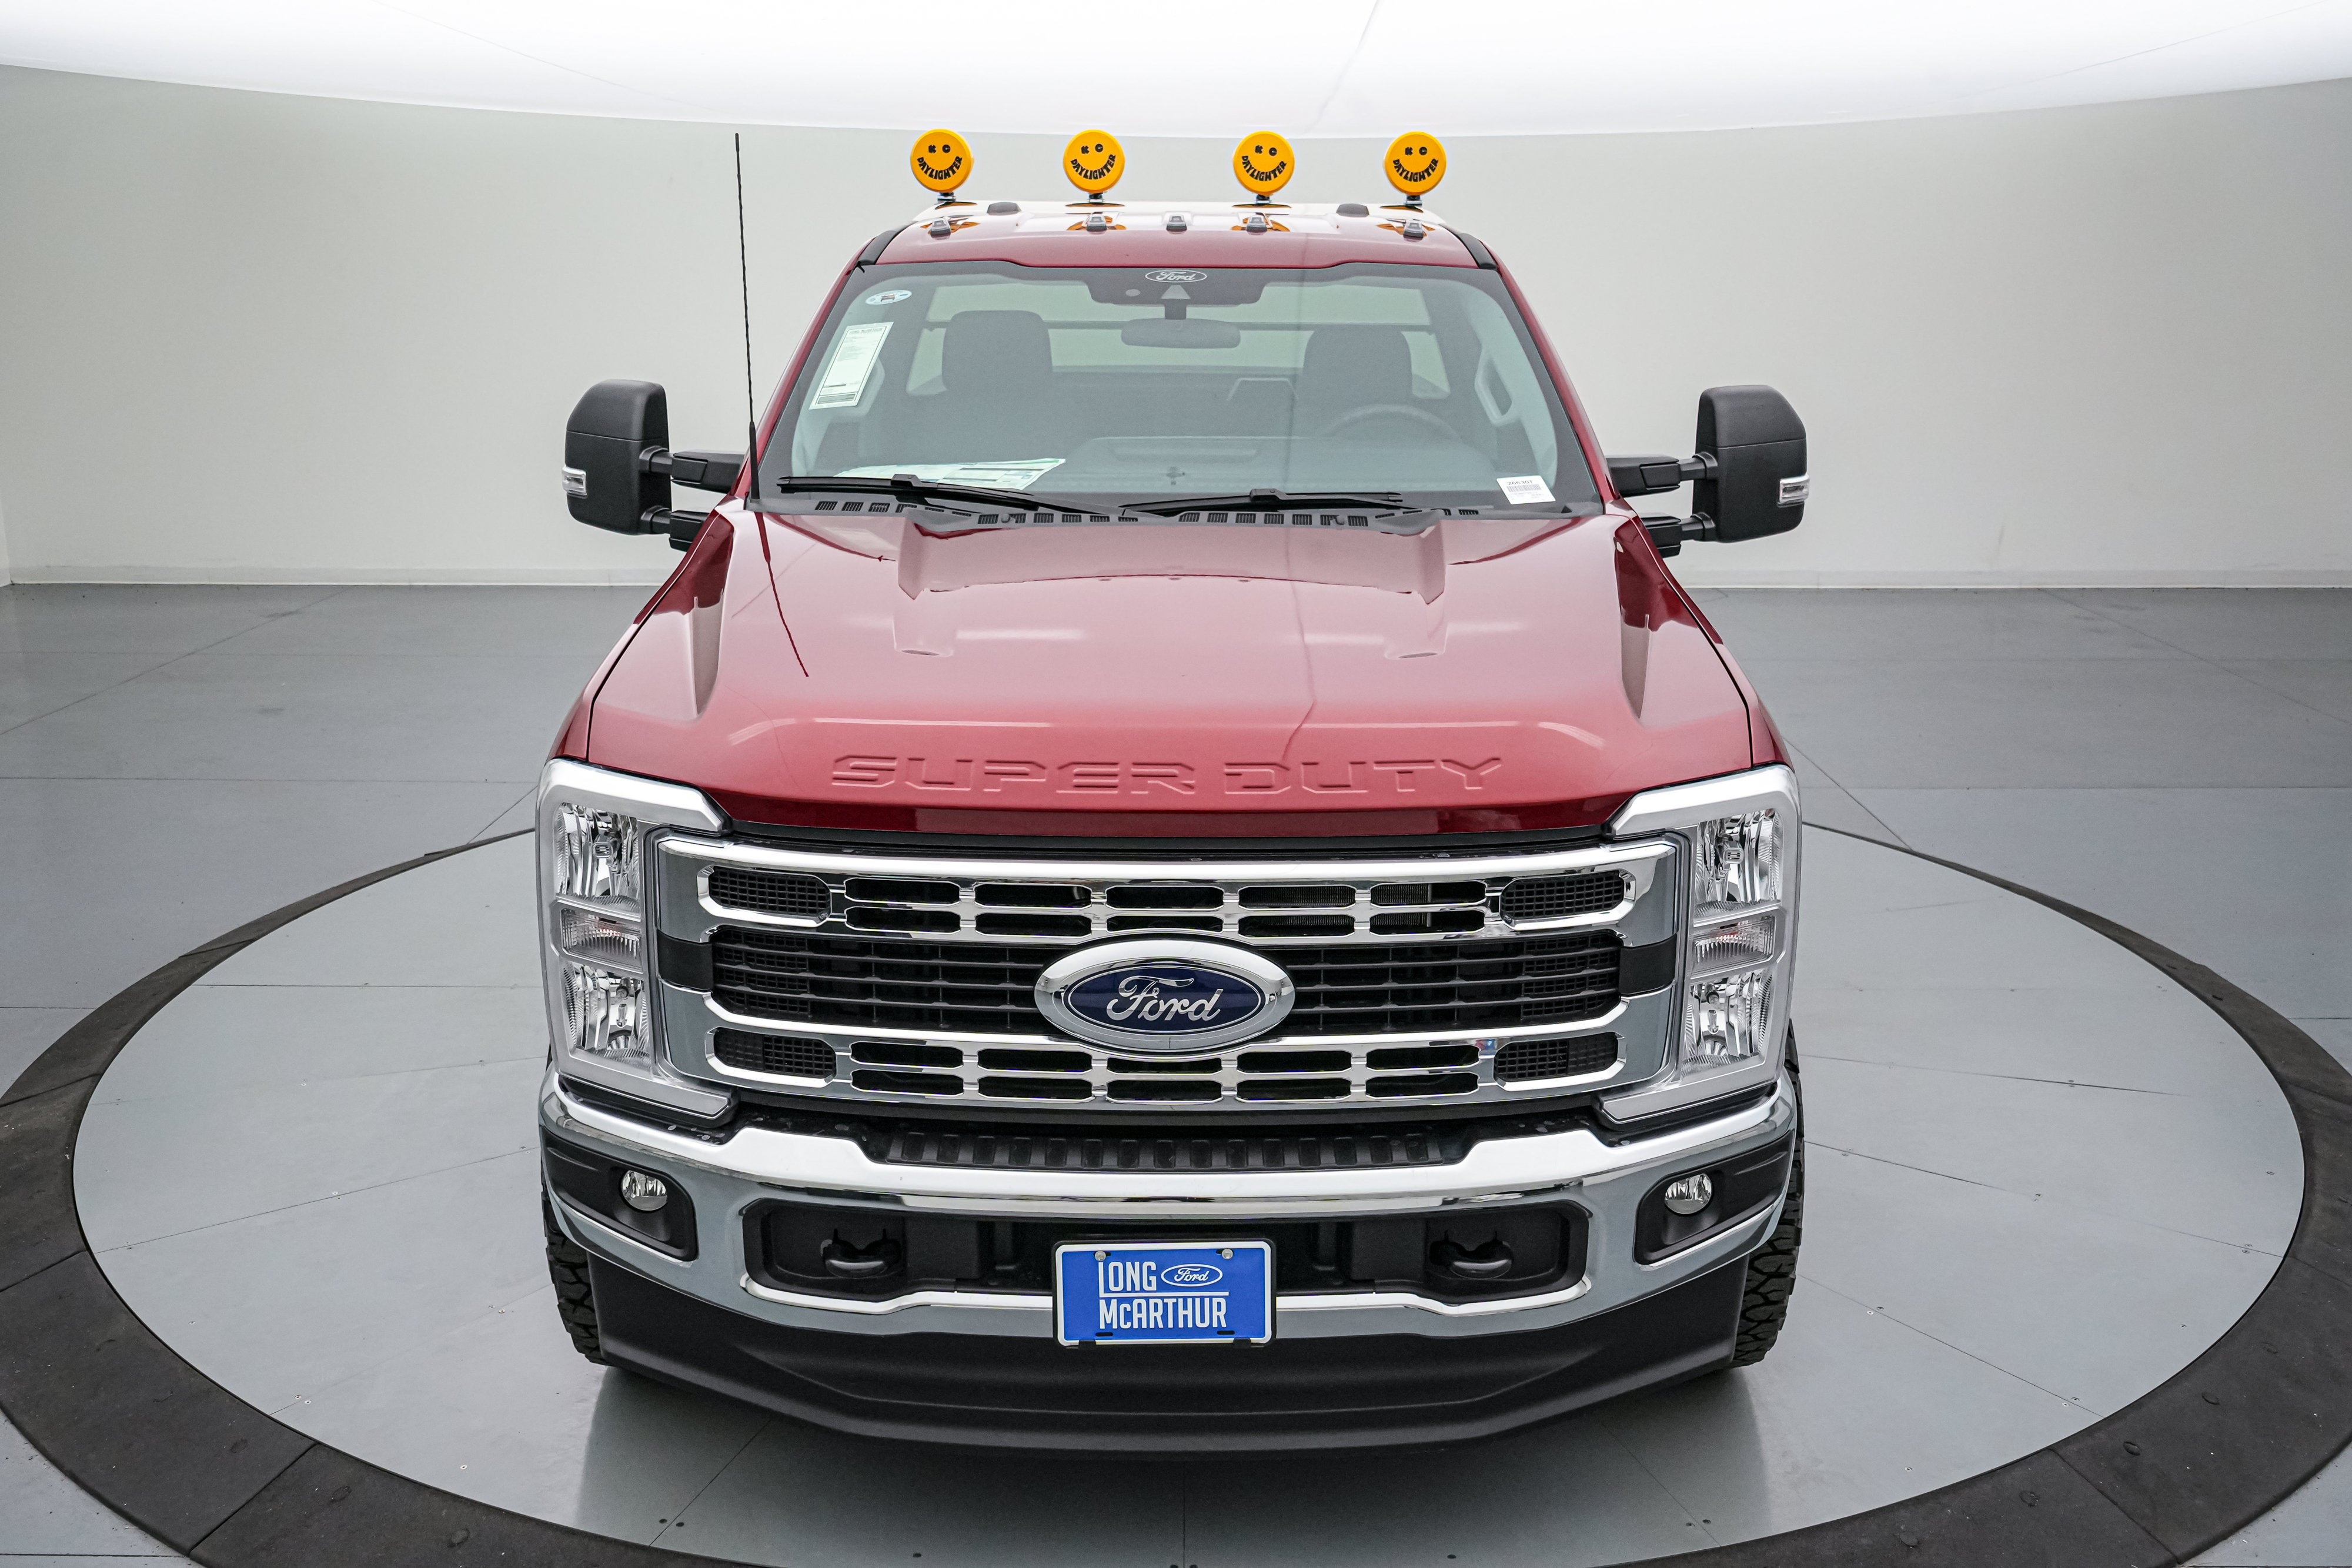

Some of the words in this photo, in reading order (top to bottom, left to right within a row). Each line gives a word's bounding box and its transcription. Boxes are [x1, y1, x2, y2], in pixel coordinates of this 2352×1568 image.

[917, 156, 963, 180] DAYLIGHTER
[1070, 154, 1116, 180] DAYLIGHTER
[1241, 155, 1287, 182] DAYLIGHTER
[1392, 158, 1439, 182] DAYLIGHTER
[1155, 270, 1196, 281] Ford
[831, 754, 1195, 795] SUPER
[1224, 757, 1502, 795] DUTY
[1106, 975, 1222, 1021] Ford
[1098, 1261, 1157, 1297] LONG
[1174, 1268, 1210, 1282] Ford
